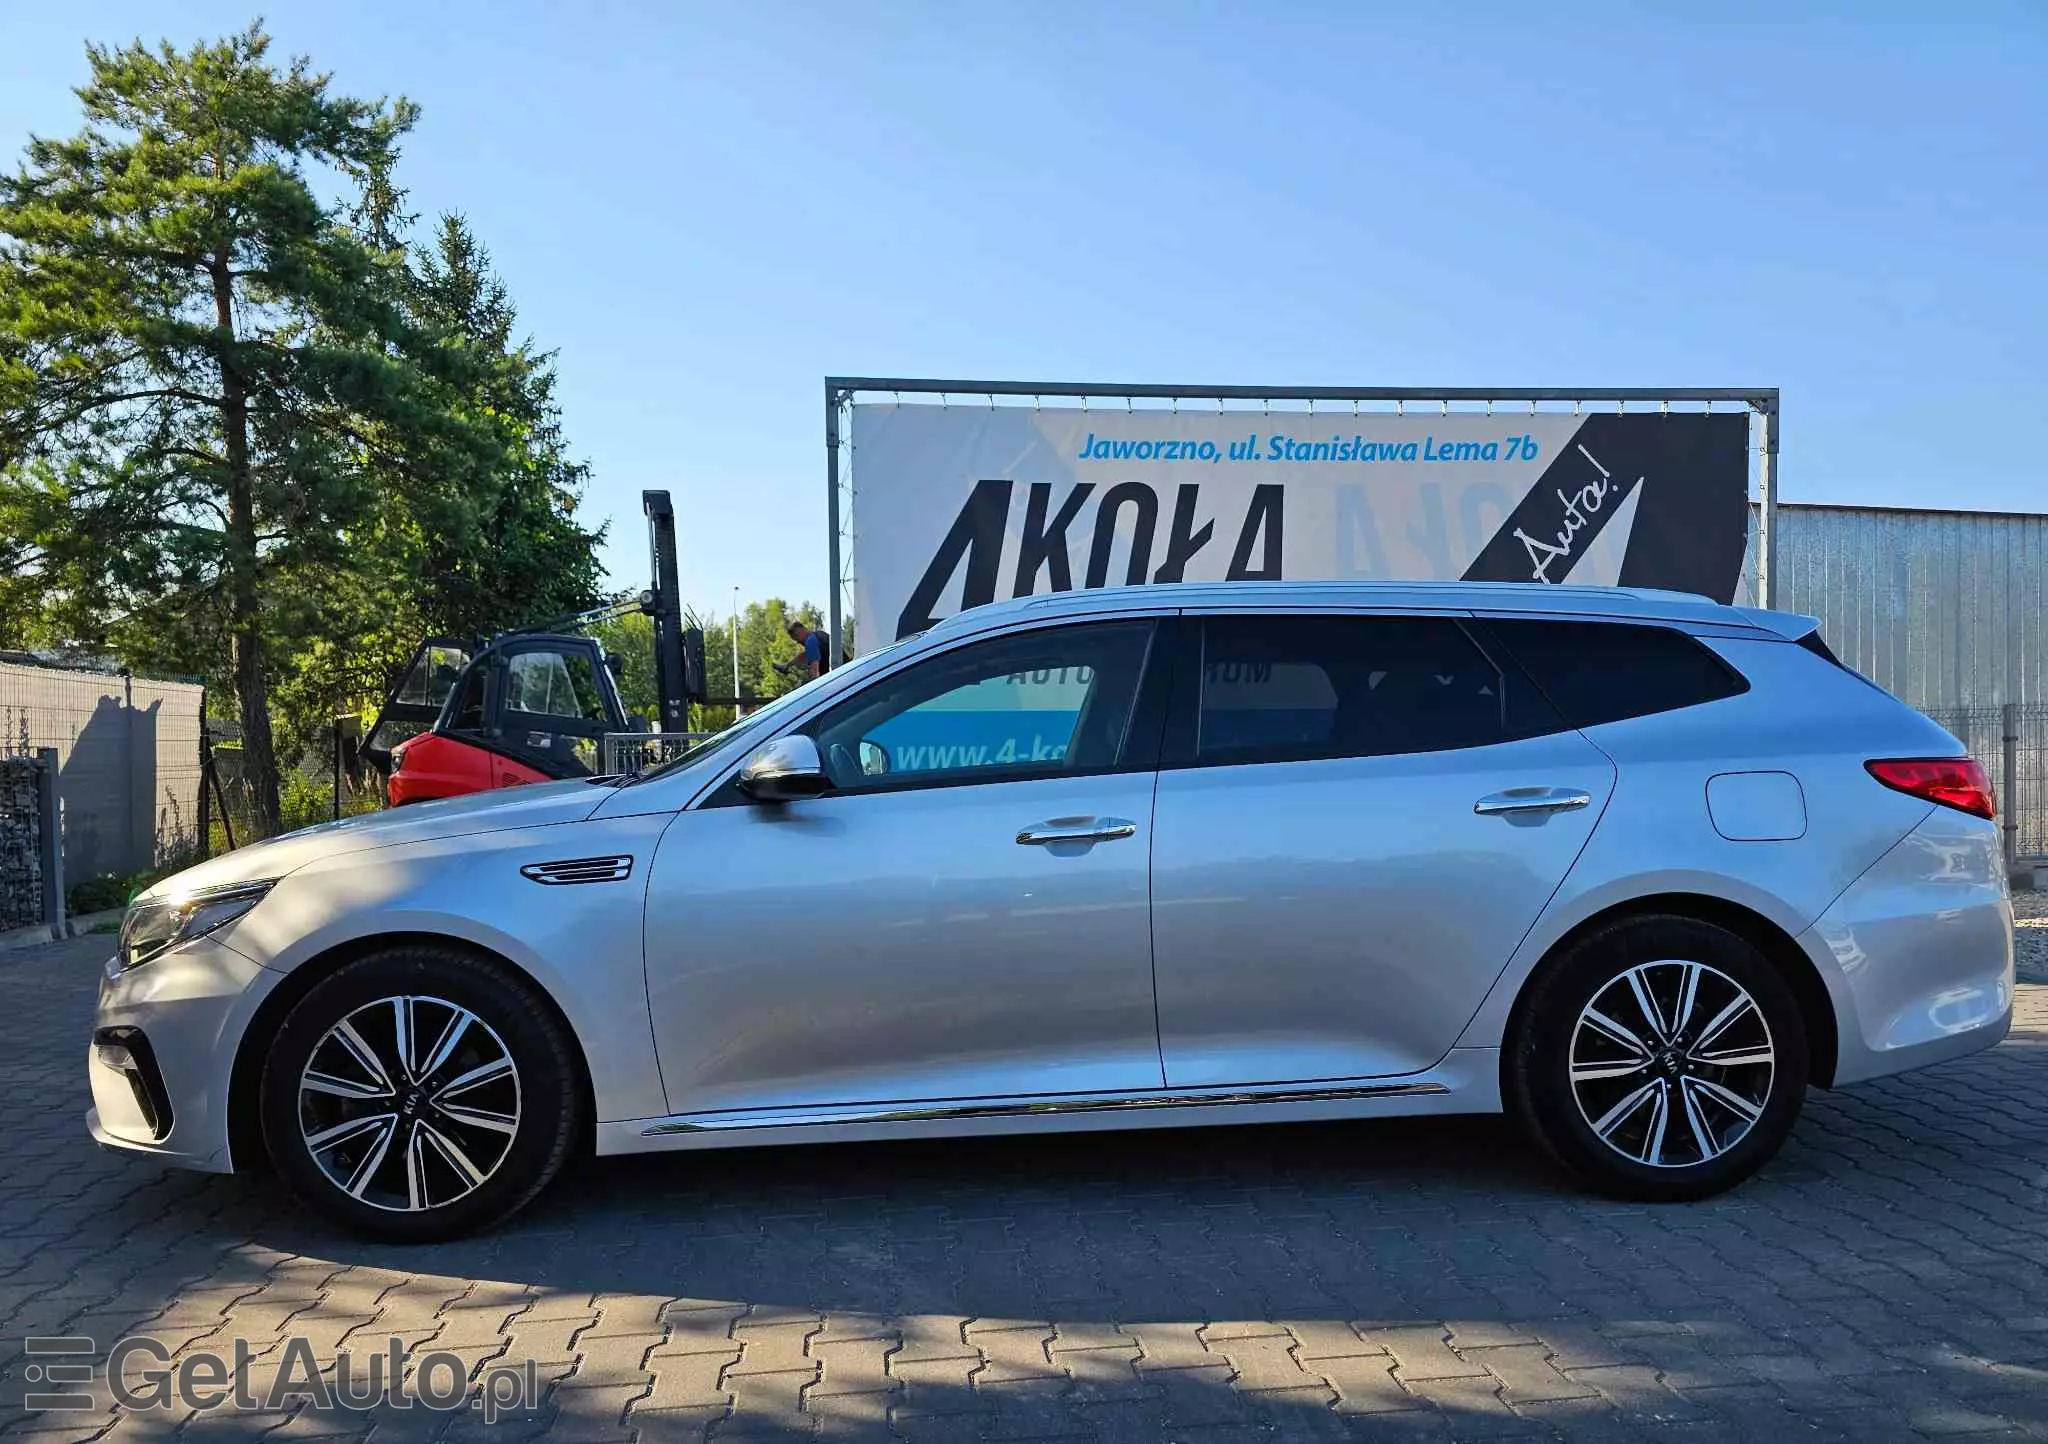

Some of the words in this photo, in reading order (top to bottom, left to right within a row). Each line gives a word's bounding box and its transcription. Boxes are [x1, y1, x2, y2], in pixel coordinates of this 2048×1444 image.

[1078, 432, 1222, 463] Jaworzno,
[1229, 434, 1260, 461] ul.
[1267, 435, 1418, 461] Stanisława
[1423, 437, 1498, 461] Lema
[1503, 435, 1539, 461] 7b
[1513, 444, 1619, 584] Auta!
[1663, 1051, 1678, 1075] KIA
[403, 1093, 420, 1115] KIA
